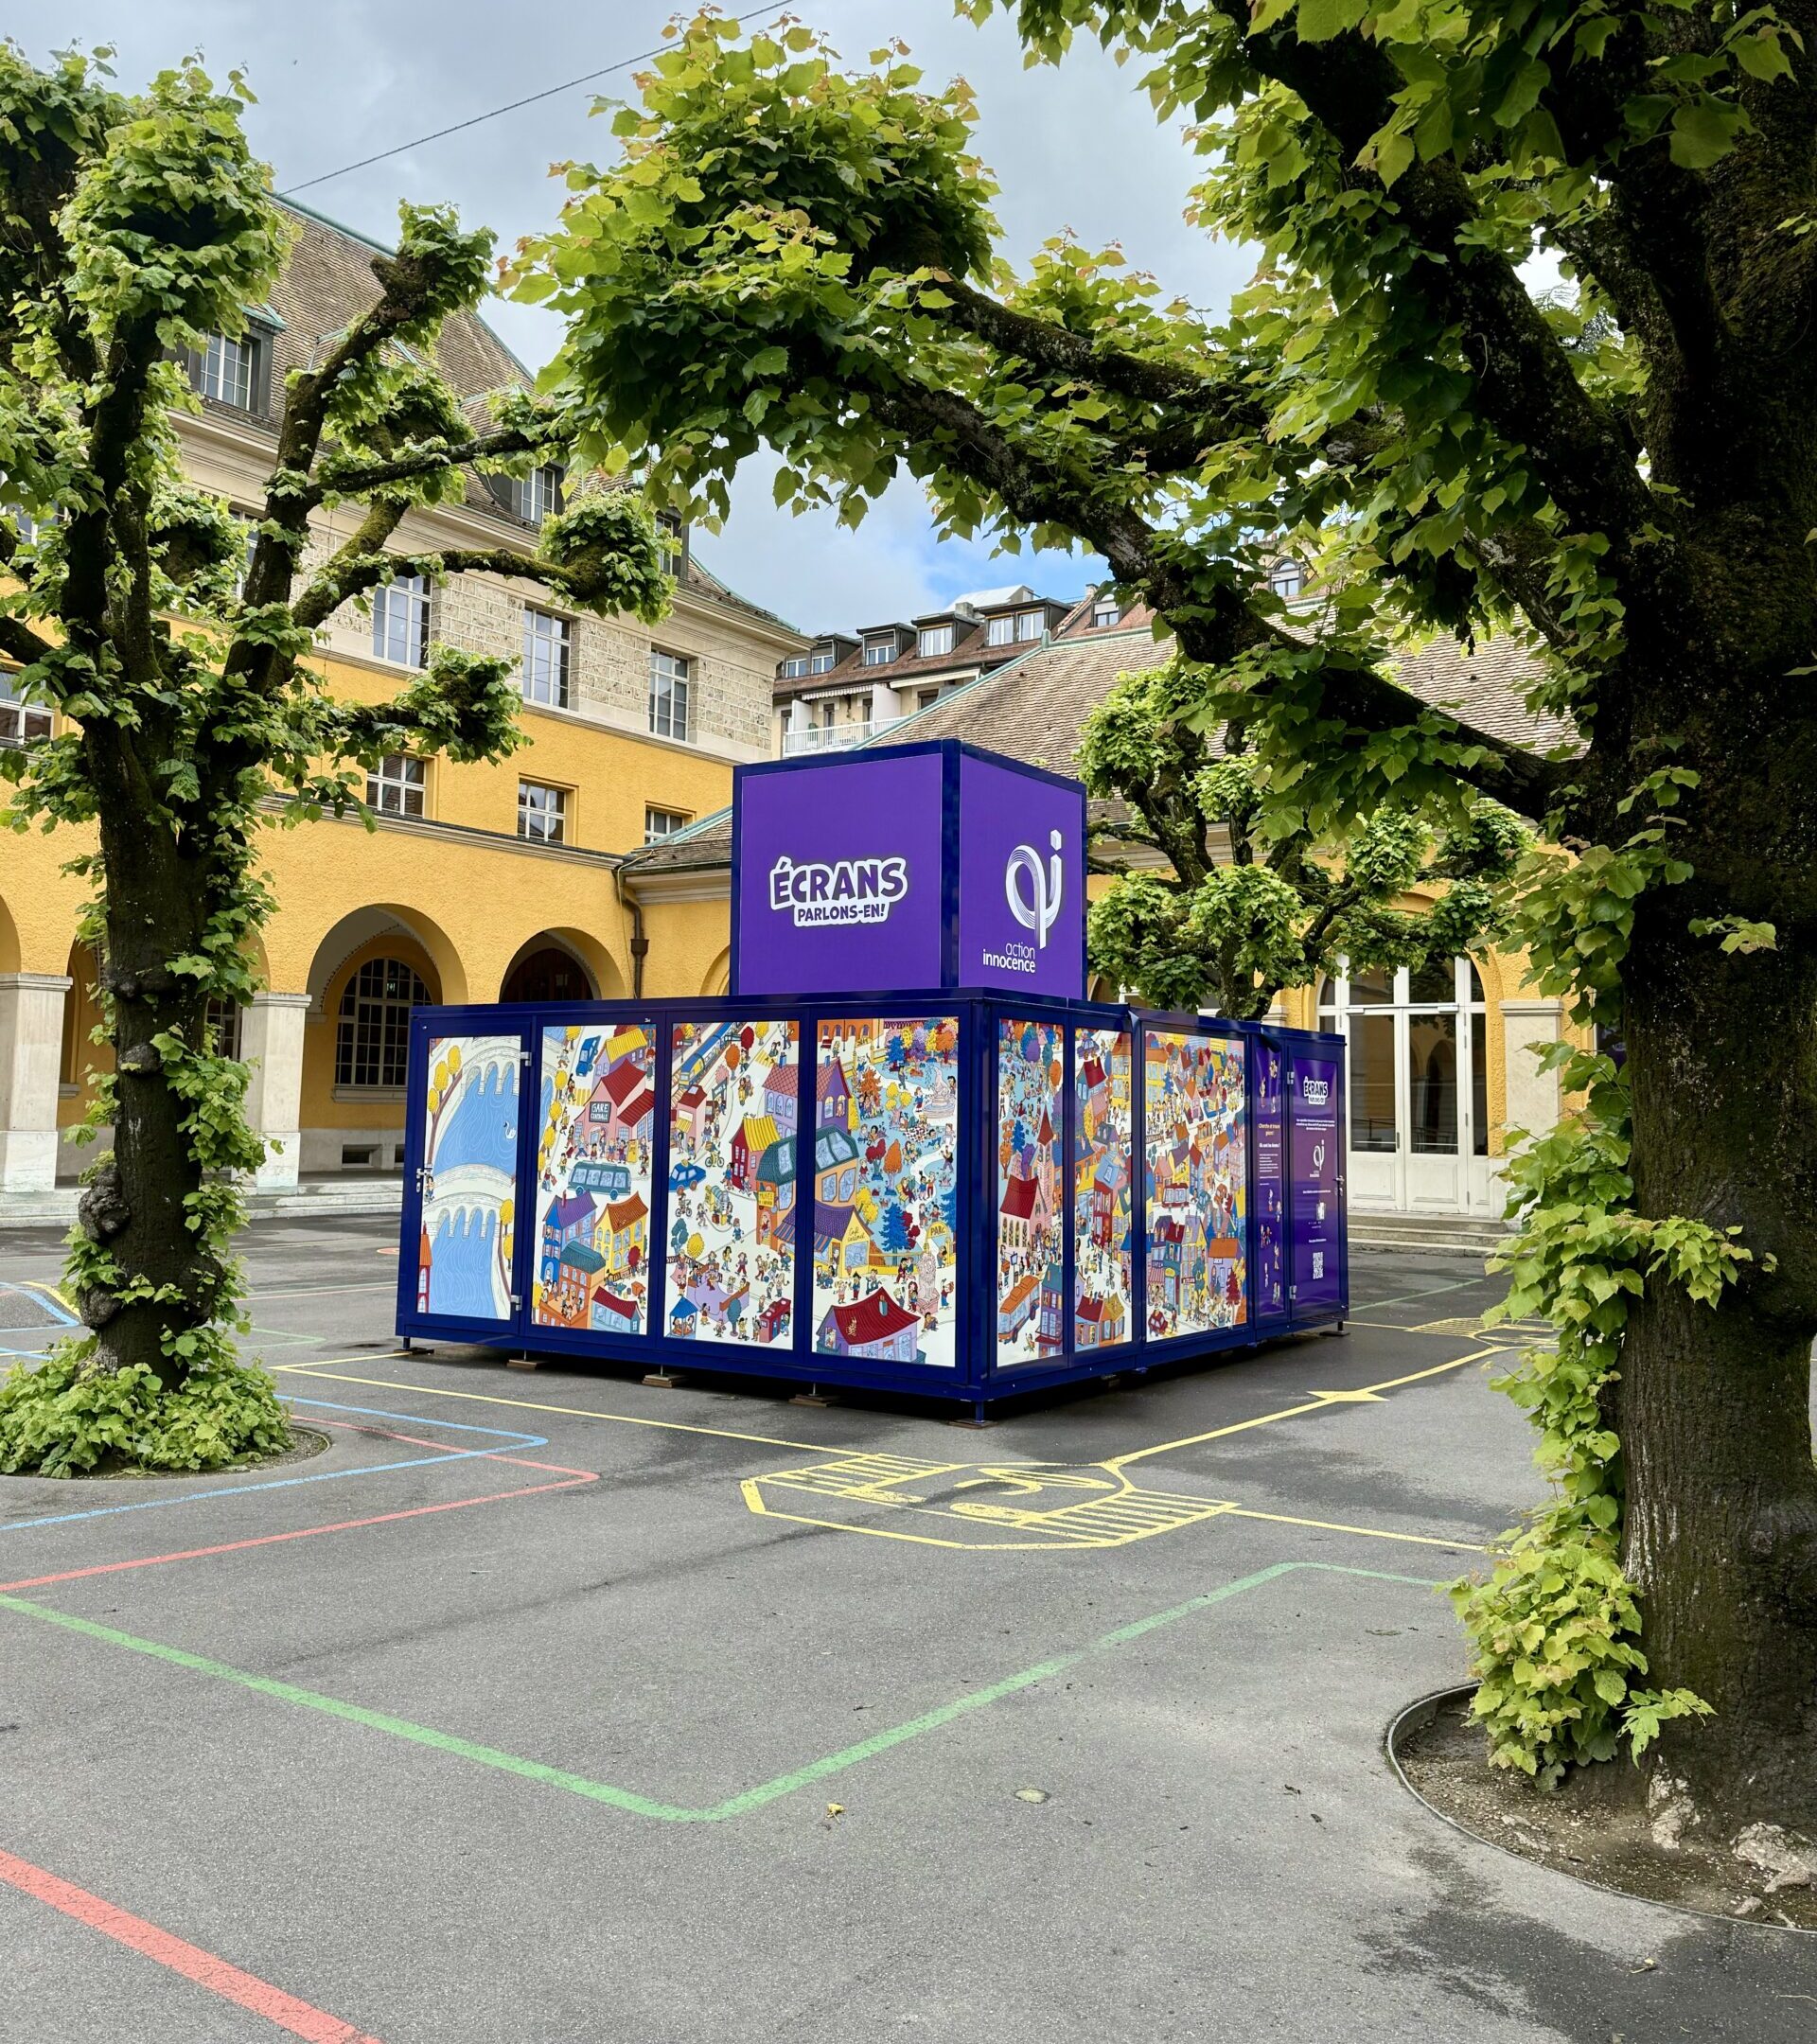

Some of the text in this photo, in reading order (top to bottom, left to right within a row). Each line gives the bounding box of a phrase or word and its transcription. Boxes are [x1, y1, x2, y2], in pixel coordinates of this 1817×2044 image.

[771, 857, 907, 907] ÉCRANS
[797, 904, 886, 923] PARLONS-EN!
[1005, 942, 1035, 960] action
[982, 948, 1036, 974] innocence
[1304, 1076, 1328, 1097] ÉCRANS
[591, 1103, 609, 1113] GARE
[930, 1225, 945, 1236] PARC
